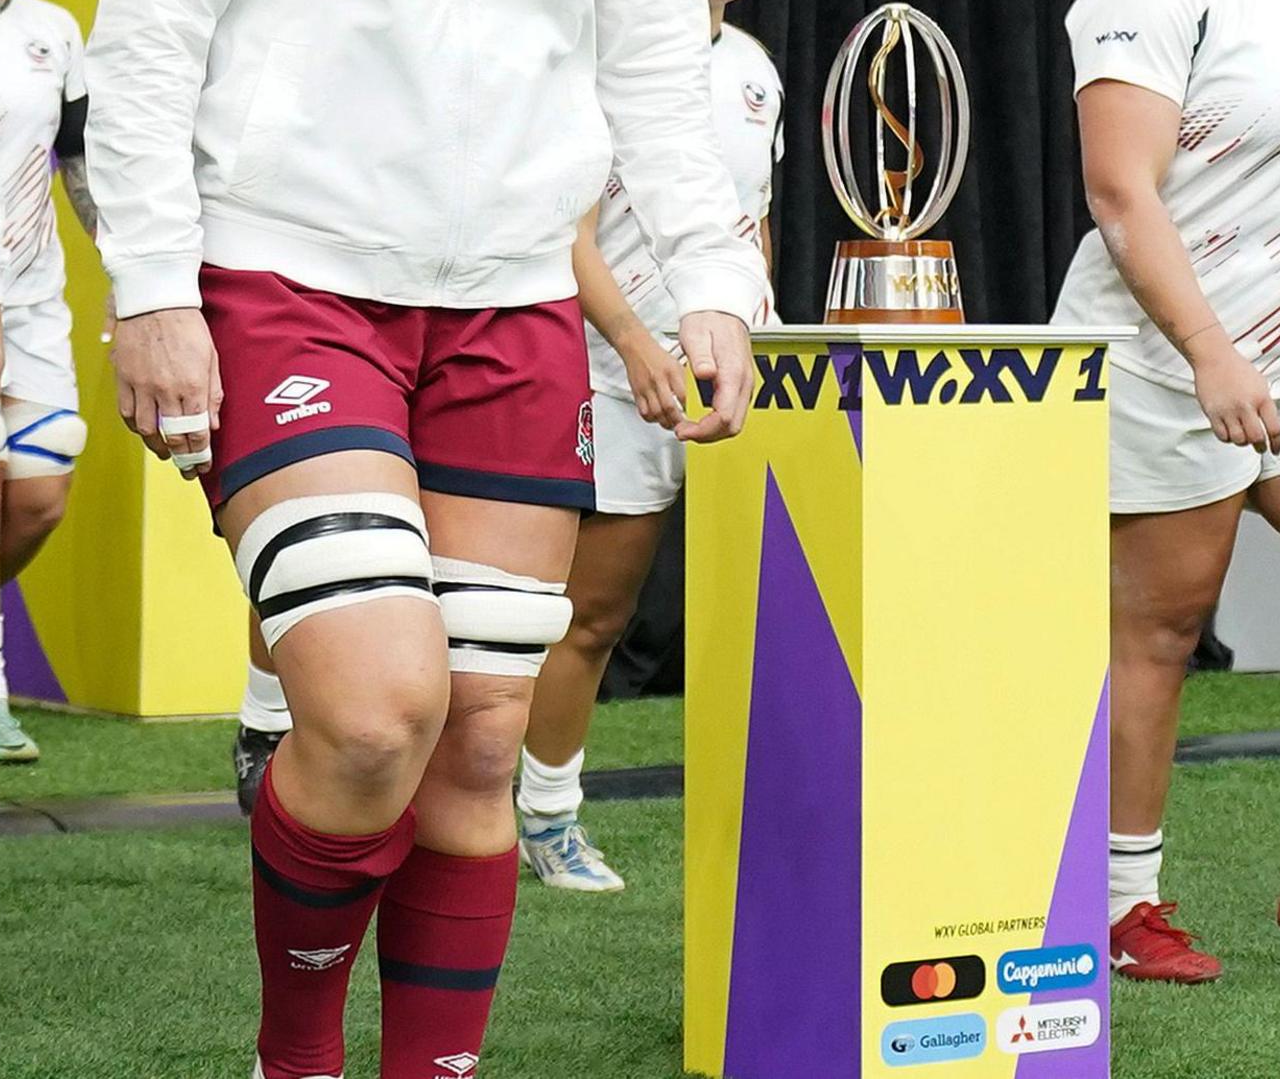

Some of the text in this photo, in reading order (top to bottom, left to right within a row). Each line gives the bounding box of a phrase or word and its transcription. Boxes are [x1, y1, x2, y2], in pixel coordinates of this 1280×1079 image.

[1073, 346, 1108, 402] 1
[275, 400, 332, 426] umbro
[933, 916, 1046, 939] WXV GLOBAL PARTNERS
[1003, 957, 1078, 987] Capgemini
[919, 1031, 981, 1050] Gallagher
